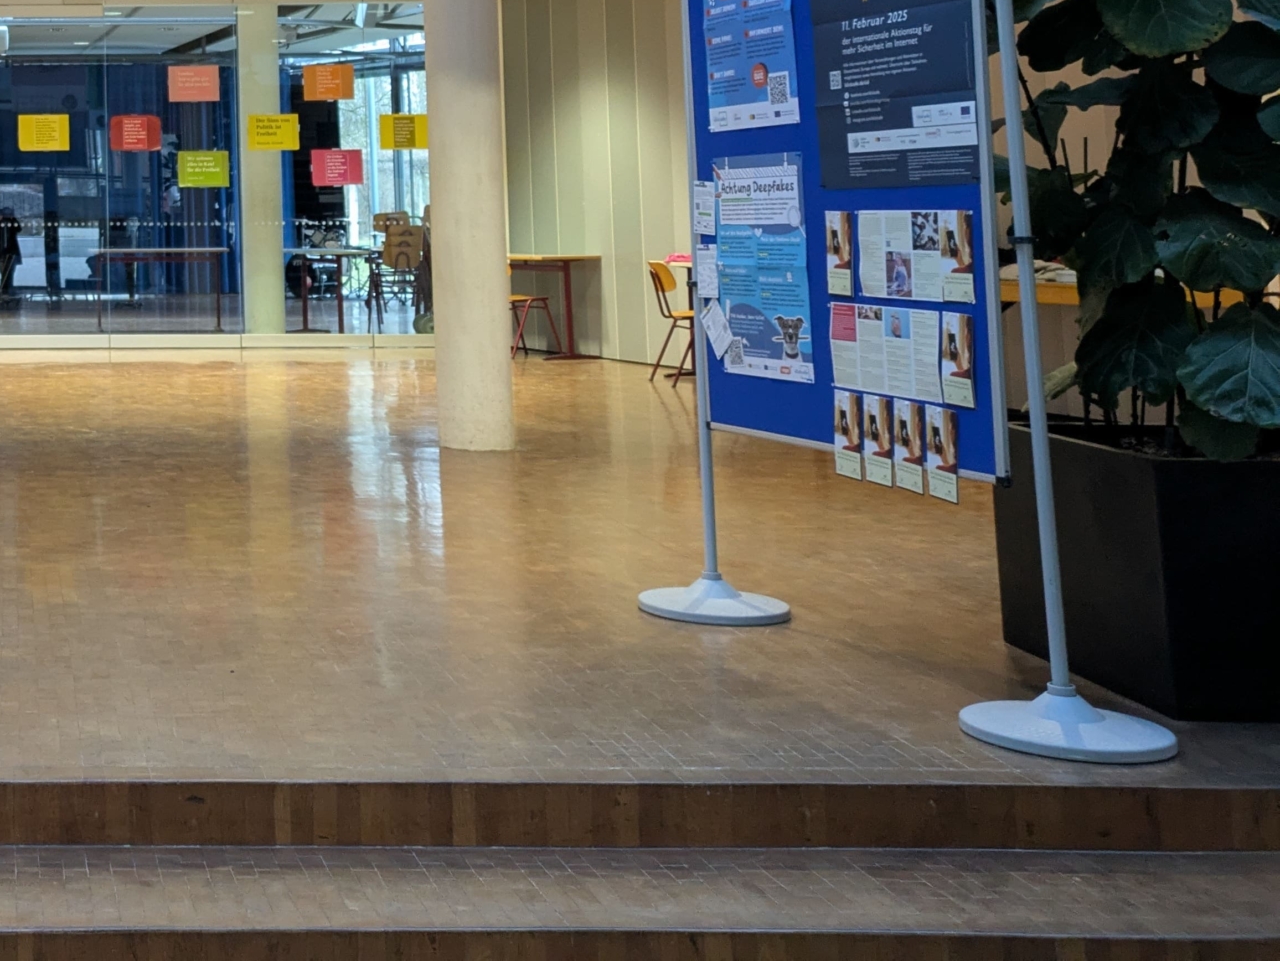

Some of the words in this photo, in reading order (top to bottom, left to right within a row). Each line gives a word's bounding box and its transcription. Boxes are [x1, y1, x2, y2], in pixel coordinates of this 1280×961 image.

[842, 21, 850, 31] 11.
[852, 16, 885, 29] Februar
[887, 10, 908, 23] 2025
[853, 31, 889, 43] internationale
[891, 27, 922, 37] Aktionstag
[923, 24, 933, 32] für
[857, 42, 884, 53] Sicherheit
[894, 38, 918, 47] Internet
[721, 182, 751, 196] Achtung
[753, 179, 794, 195] Deepfakes
